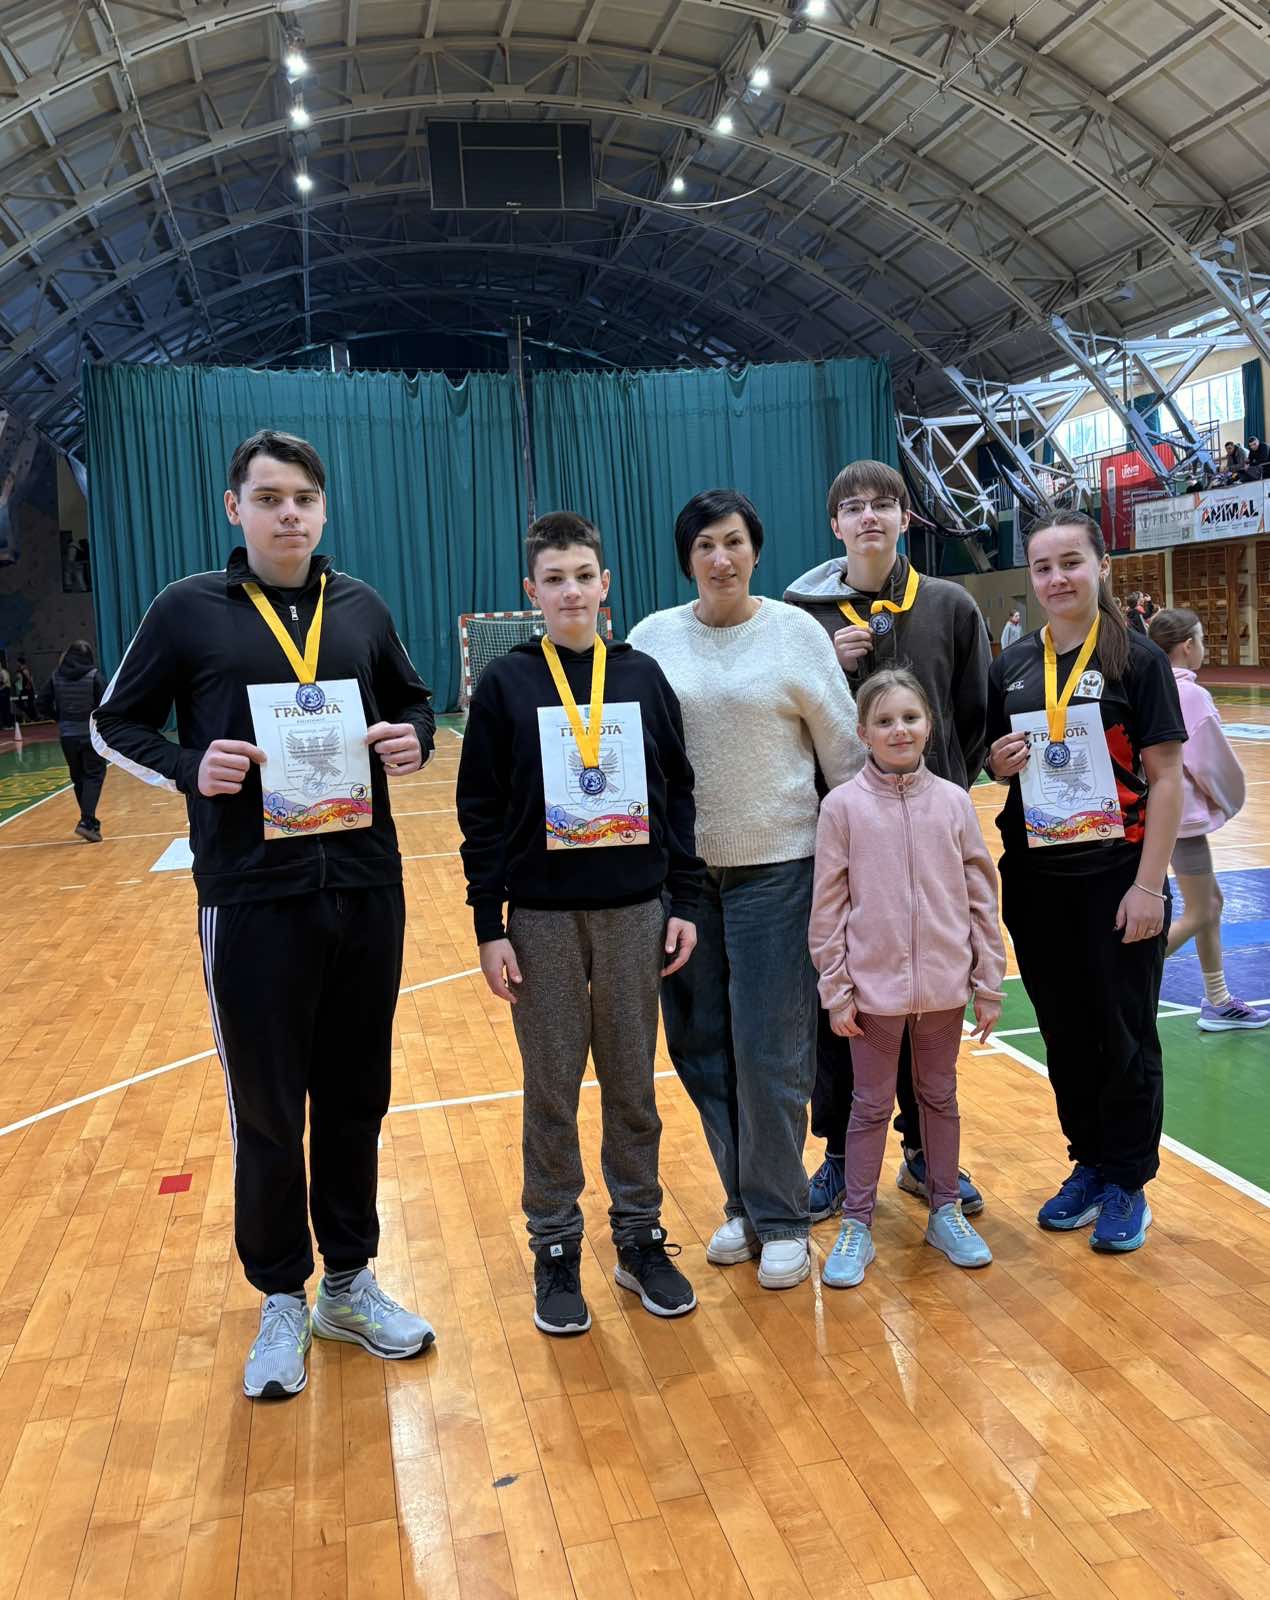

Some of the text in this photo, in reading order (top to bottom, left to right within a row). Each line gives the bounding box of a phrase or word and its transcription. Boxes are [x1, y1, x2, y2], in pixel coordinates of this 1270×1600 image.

[1201, 498, 1259, 525] ANIMAL
[560, 725, 622, 737] ГРОТА
[1032, 727, 1088, 743] ГРОТА
